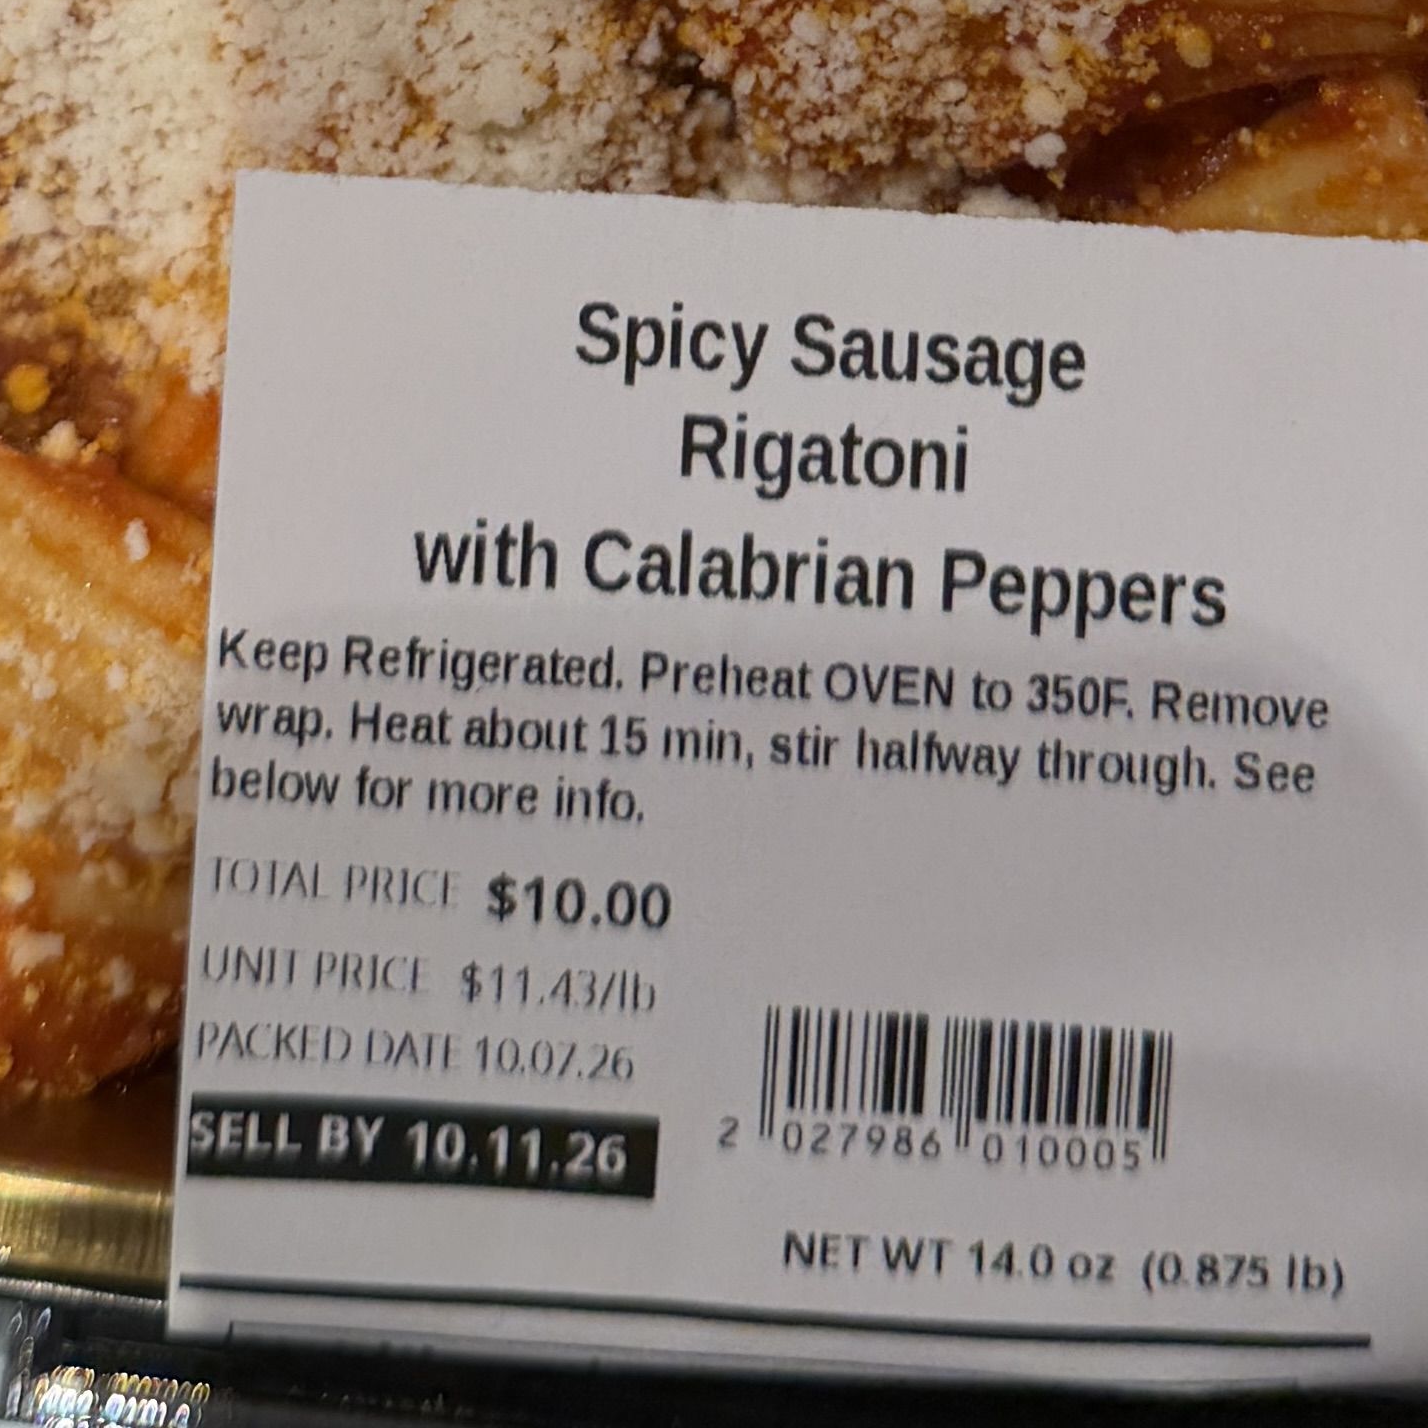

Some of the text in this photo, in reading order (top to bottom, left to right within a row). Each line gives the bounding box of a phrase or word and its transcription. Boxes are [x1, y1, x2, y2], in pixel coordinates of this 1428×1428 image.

[575, 301, 1087, 408] Spicy Sausage
[679, 413, 970, 500] Rigatoni
[413, 517, 1228, 639] with Calabrian Peppers
[217, 625, 1330, 730] Keep Refrigerated. Preheat OVEN to 350F. Remove
[217, 698, 1316, 796] wrap. Heat about 15 min, stir halfway through. See
[210, 755, 646, 822] below for more info.
[212, 856, 673, 929] TOTAL PRICE $10.00
[201, 943, 657, 1011] UNIT PRICE $11.43/lb
[196, 1020, 634, 1081] PACKED DATE 10.07.26
[189, 1110, 629, 1177] SELL BY 10.11.26
[718, 1116, 1142, 1171] 2 027986 010005
[783, 1229, 1345, 1296] NET WT 14.0 oz (0.875 lb)
